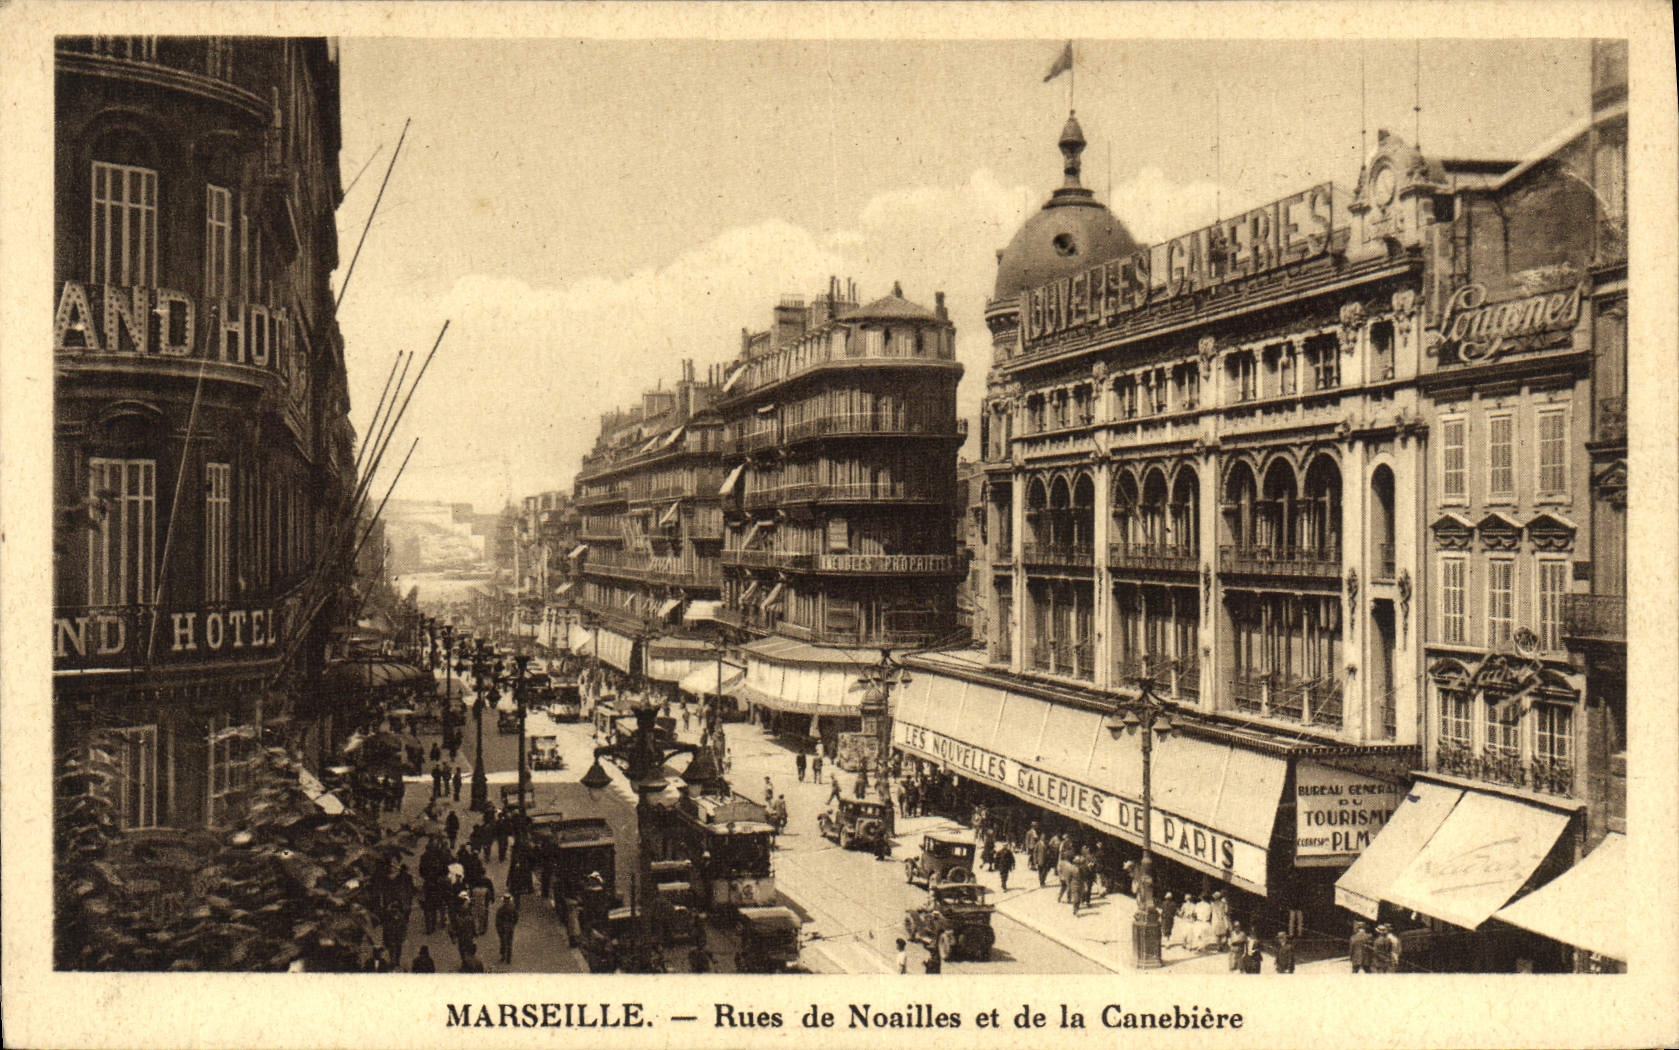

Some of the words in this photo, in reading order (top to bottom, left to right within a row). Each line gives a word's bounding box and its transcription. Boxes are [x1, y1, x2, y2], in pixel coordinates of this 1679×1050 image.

[1167, 183, 1331, 297] GALERIES
[171, 608, 276, 651] HOTEL
[905, 726, 926, 750] LES
[933, 737, 1006, 781] NOUVELLES
[1018, 768, 1104, 817] GALERIES
[1119, 802, 1144, 833] DE
[1163, 817, 1234, 869] PARIS
[1298, 784, 1343, 796] BUREAU
[1304, 809, 1396, 827] TOURISME
